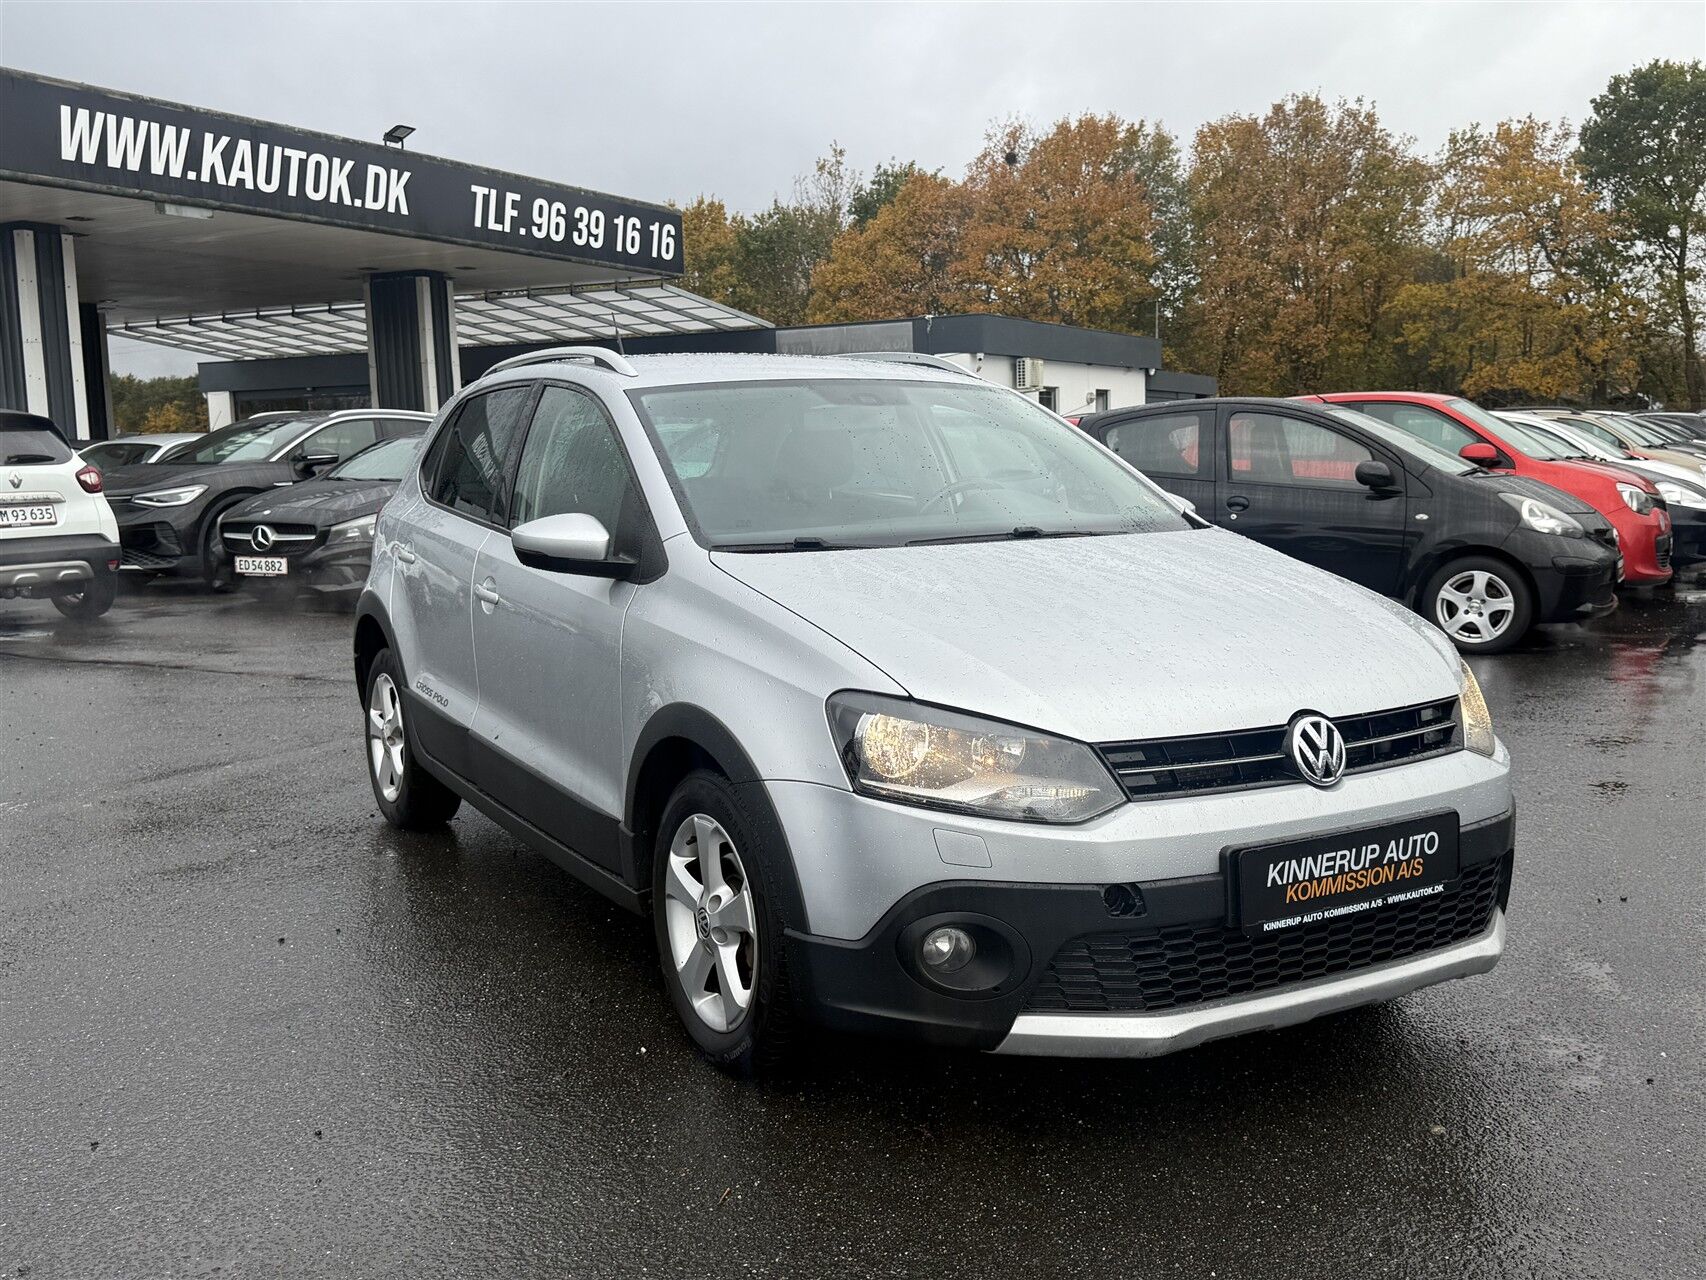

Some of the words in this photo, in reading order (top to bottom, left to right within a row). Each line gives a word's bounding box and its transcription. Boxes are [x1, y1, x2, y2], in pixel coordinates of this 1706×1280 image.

[60, 104, 411, 216] WWW.KAUTOK.DK
[470, 184, 526, 236] TLF.
[531, 197, 567, 242] 96
[572, 206, 605, 249] 39
[613, 214, 642, 255] 16
[648, 221, 676, 261] 16
[11, 509, 27, 521] 93
[30, 508, 53, 520] 635
[264, 560, 283, 572] 882
[416, 680, 434, 697] CROSS
[433, 692, 449, 707] POLO
[1266, 843, 1380, 888] KINNERUP
[1382, 831, 1439, 865] AUTO
[1285, 863, 1395, 904] KOMMISSION
[1396, 857, 1425, 880] A/S
[1263, 916, 1302, 932] KINNERUP
[1302, 911, 1323, 924] AUTO
[1323, 901, 1370, 919] KOMMISSION
[1370, 898, 1383, 909] A/S
[1387, 883, 1445, 905] WWW.KAUTOK.DK
